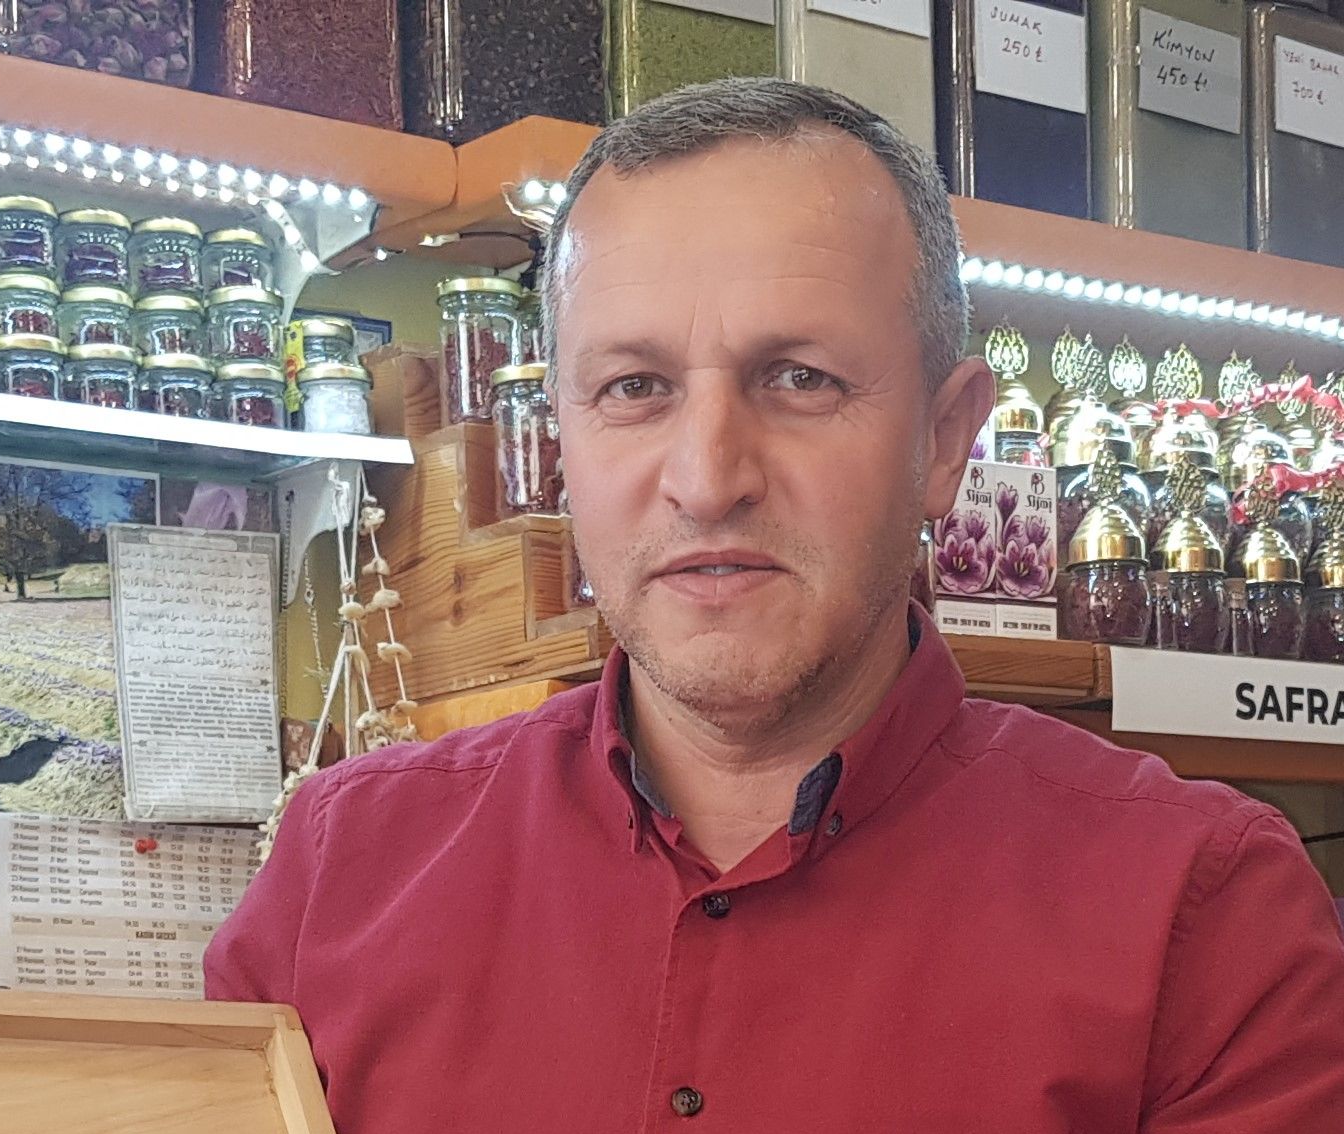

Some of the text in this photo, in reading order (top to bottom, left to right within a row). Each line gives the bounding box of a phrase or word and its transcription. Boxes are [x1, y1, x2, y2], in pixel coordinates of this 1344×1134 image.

[990, 6, 1043, 35] SUMAK
[1002, 37, 1030, 58] 250
[1156, 66, 1187, 86] 450
